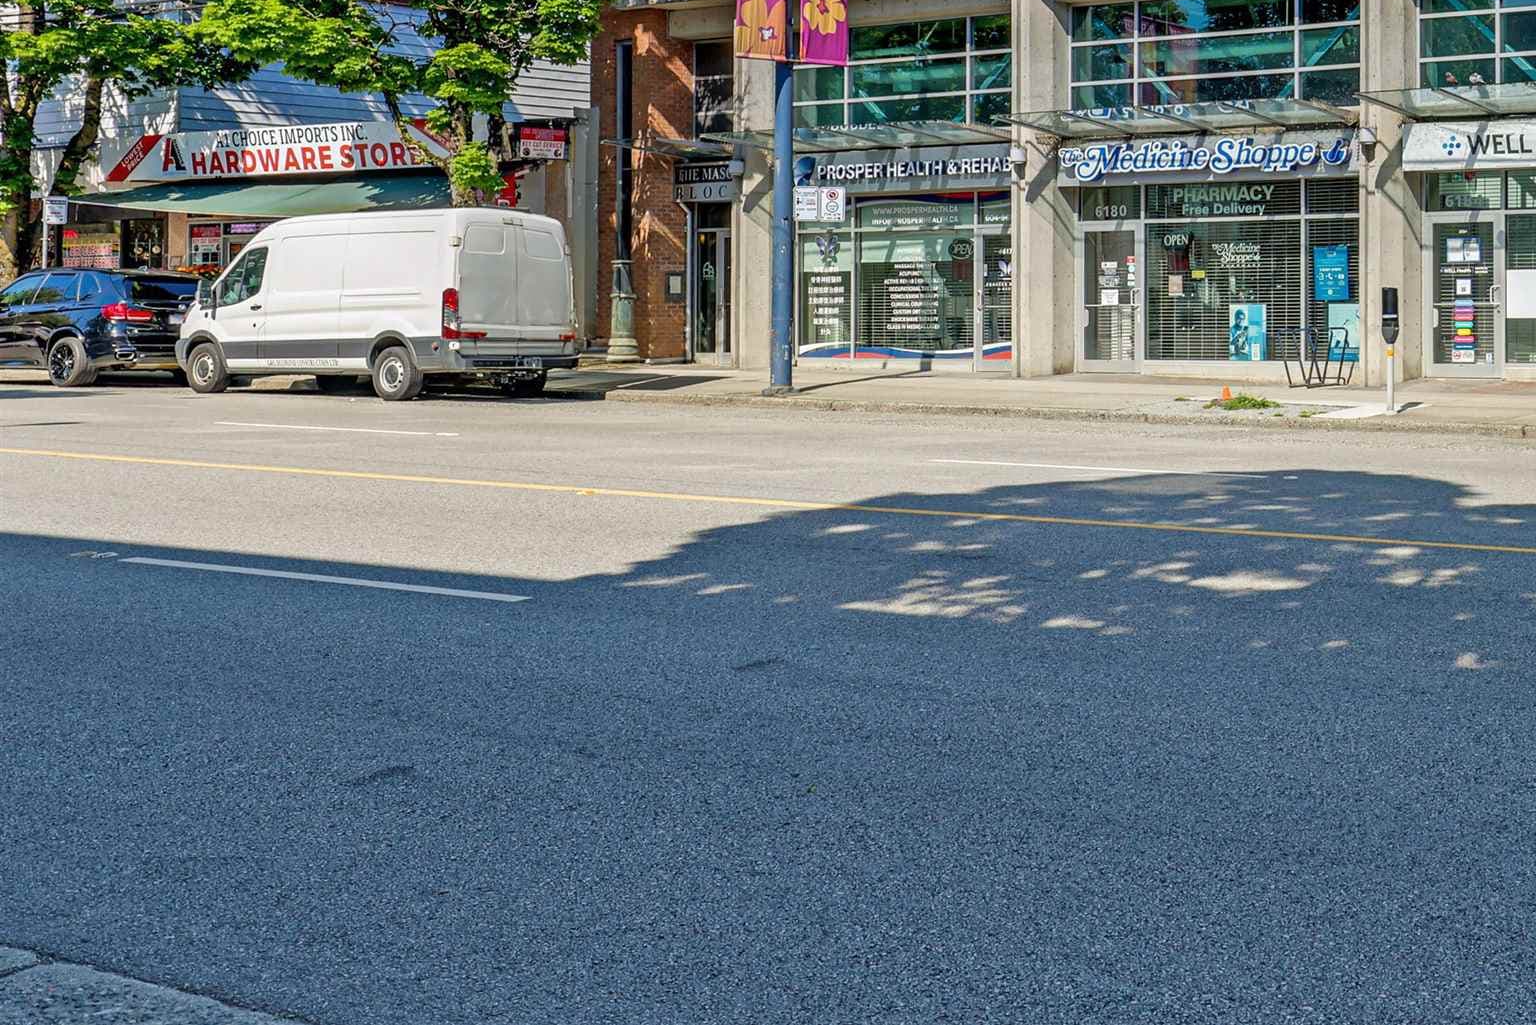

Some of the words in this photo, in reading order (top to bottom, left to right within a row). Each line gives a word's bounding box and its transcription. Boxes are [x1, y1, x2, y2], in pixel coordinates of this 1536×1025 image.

[231, 129, 277, 146] CHOICE
[280, 126, 338, 145] IMPORTS
[340, 125, 368, 142] INC.
[1467, 134, 1533, 156] WELL
[121, 141, 144, 167] LOWEST
[127, 149, 145, 172] PRICE
[191, 145, 334, 175] HARDWARE
[1059, 147, 1085, 167] The
[1076, 140, 1209, 181] Medicine
[1210, 138, 1316, 173] Shoppe
[817, 162, 884, 180] PROSPER
[886, 160, 942, 177] HEALTH
[946, 160, 958, 175] &
[961, 157, 1012, 174] REHAB
[1173, 184, 1274, 203] PHARMACY
[872, 205, 959, 215] WWW.PROSPERHEALTH.CA
[1095, 205, 1127, 218] 6180
[1182, 204, 1209, 216] Free
[1213, 203, 1265, 217] Delivery
[1163, 234, 1189, 246] OPEN
[1216, 242, 1261, 256] Medicine
[1221, 252, 1253, 264] Shoppe
